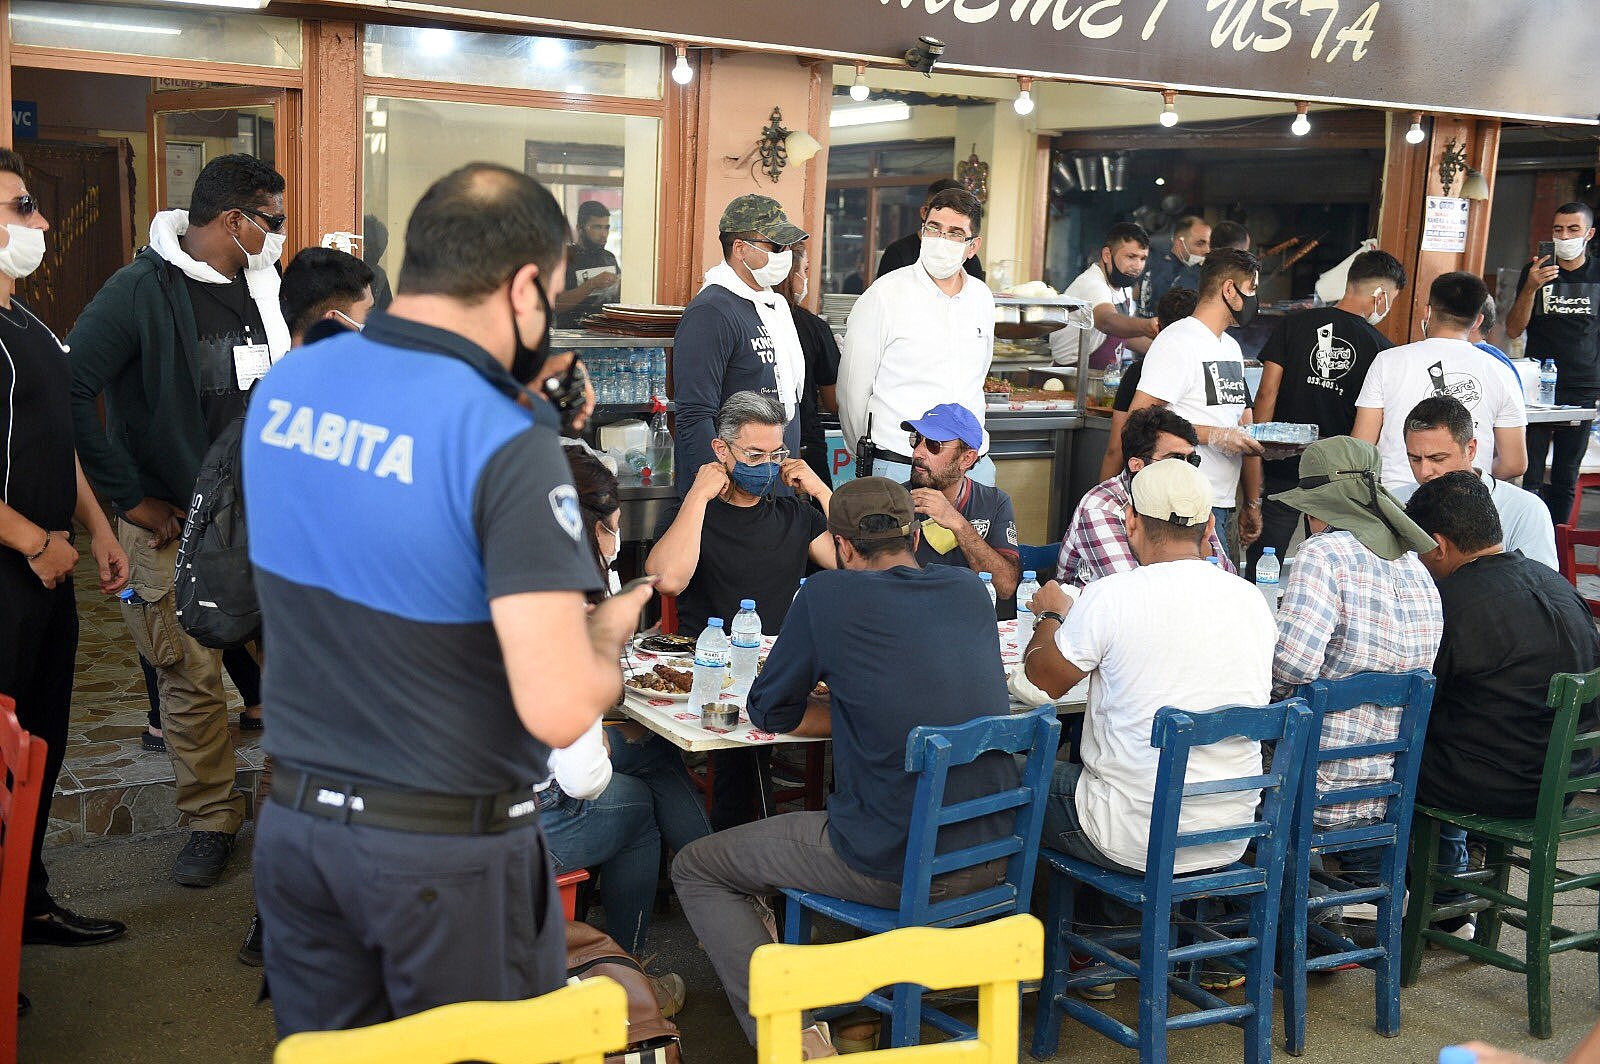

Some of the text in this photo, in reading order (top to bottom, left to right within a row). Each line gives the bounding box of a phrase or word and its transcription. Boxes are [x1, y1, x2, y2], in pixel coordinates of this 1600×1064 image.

[1206, 0, 1380, 63] USTA
[260, 398, 415, 485] ZABITA
[833, 448, 852, 476] P
